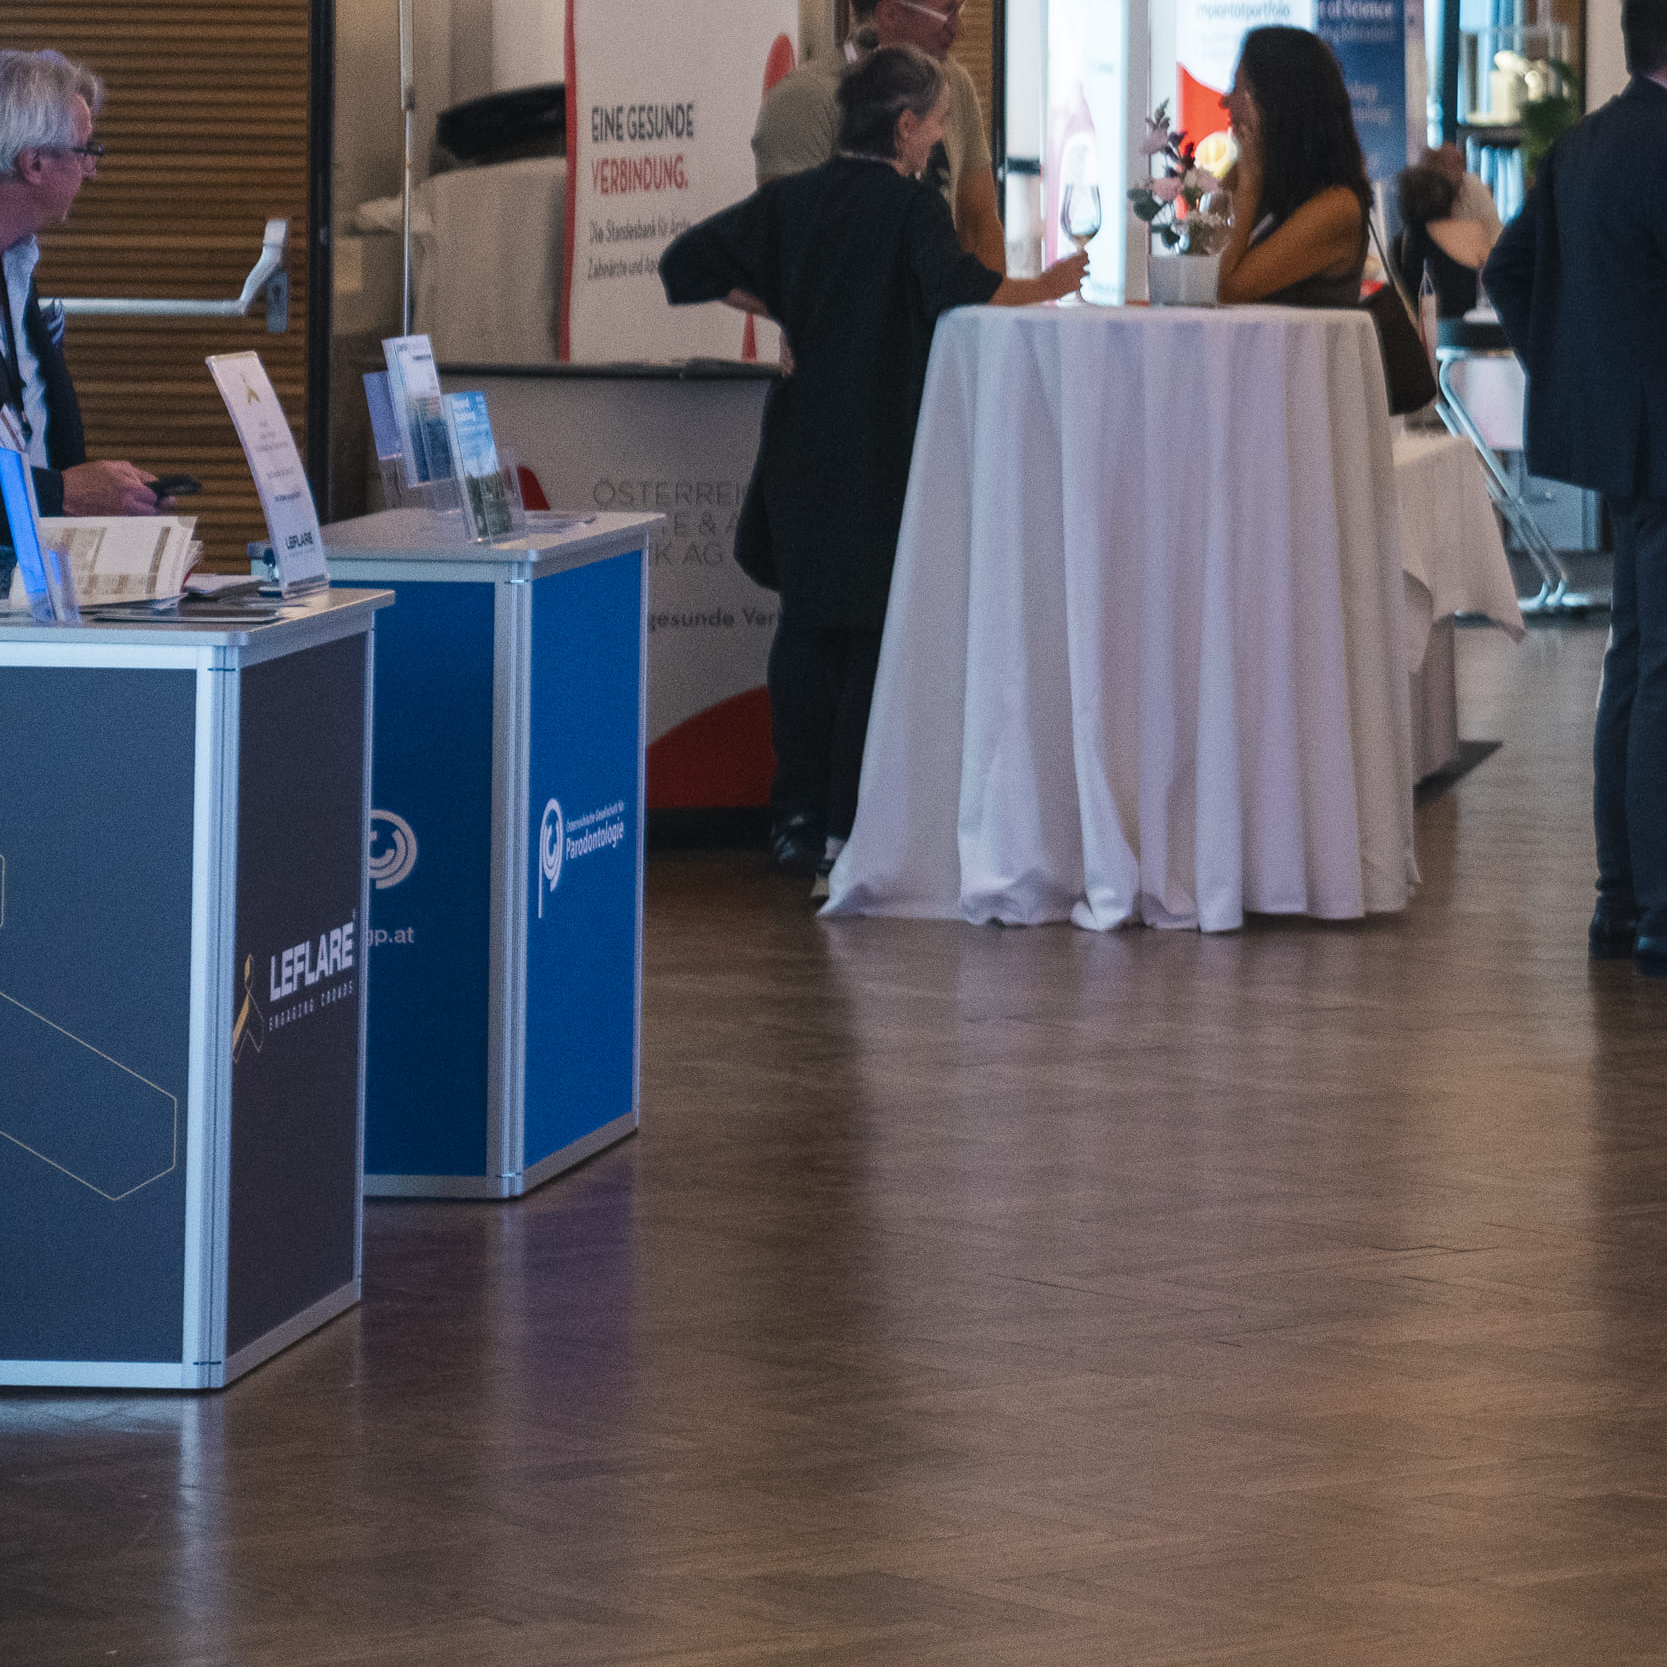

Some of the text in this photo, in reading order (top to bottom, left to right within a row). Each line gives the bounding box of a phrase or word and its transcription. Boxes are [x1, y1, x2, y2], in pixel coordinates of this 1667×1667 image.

[592, 103, 694, 142] EINE GESUNDE
[592, 154, 689, 195] VERBINDUNG.
[593, 479, 744, 507] ÖSTERREI
[566, 816, 624, 861] Parodontologie
[270, 922, 354, 1002] LEFLARE
